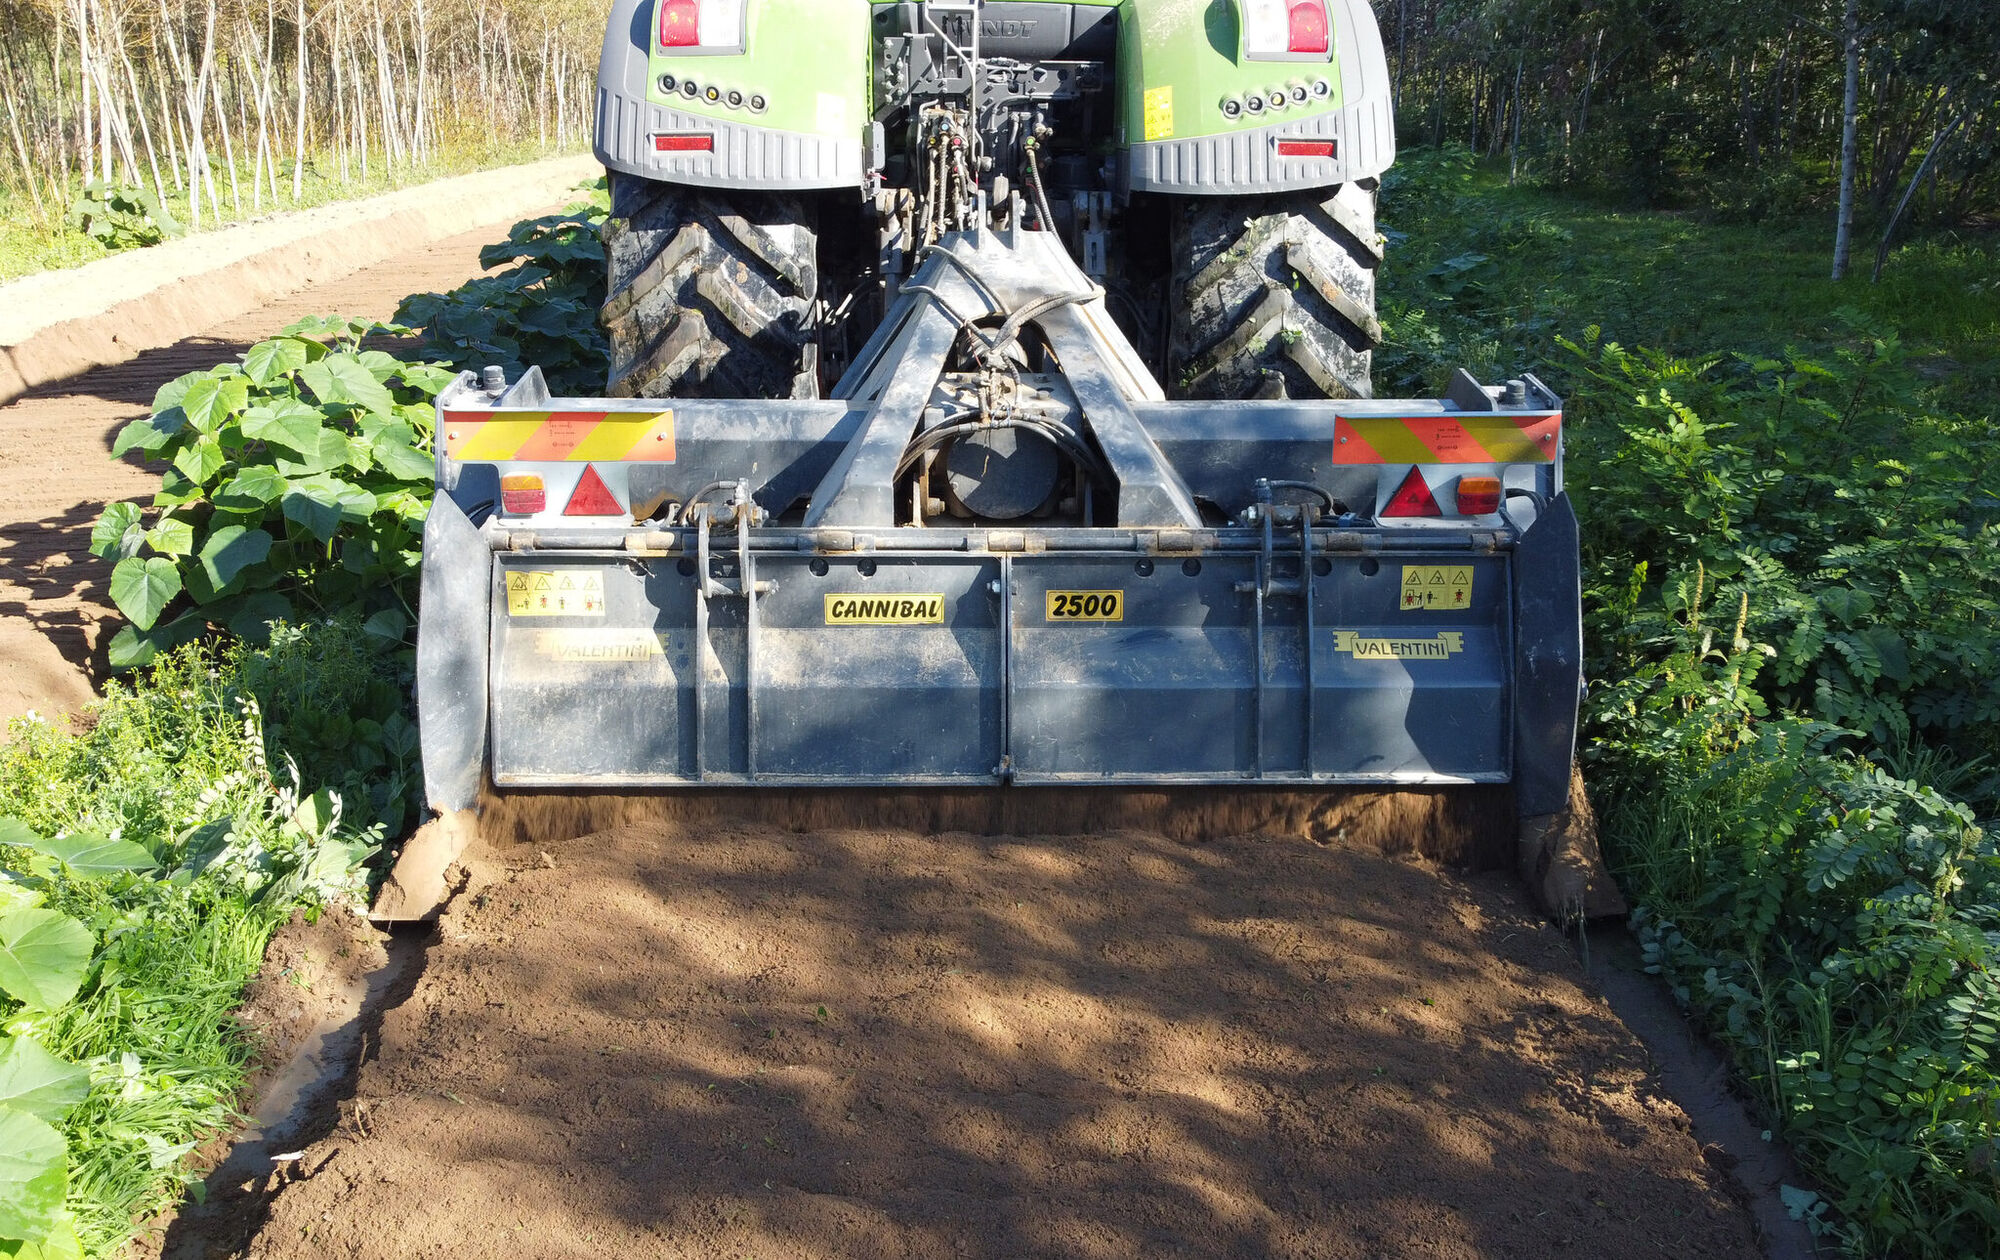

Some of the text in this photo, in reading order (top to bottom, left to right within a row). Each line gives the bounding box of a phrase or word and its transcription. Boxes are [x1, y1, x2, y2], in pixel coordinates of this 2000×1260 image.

[832, 600, 938, 618] CANNIBAL
[1053, 594, 1117, 617] 2500
[1355, 642, 1446, 656] VALENTINI
